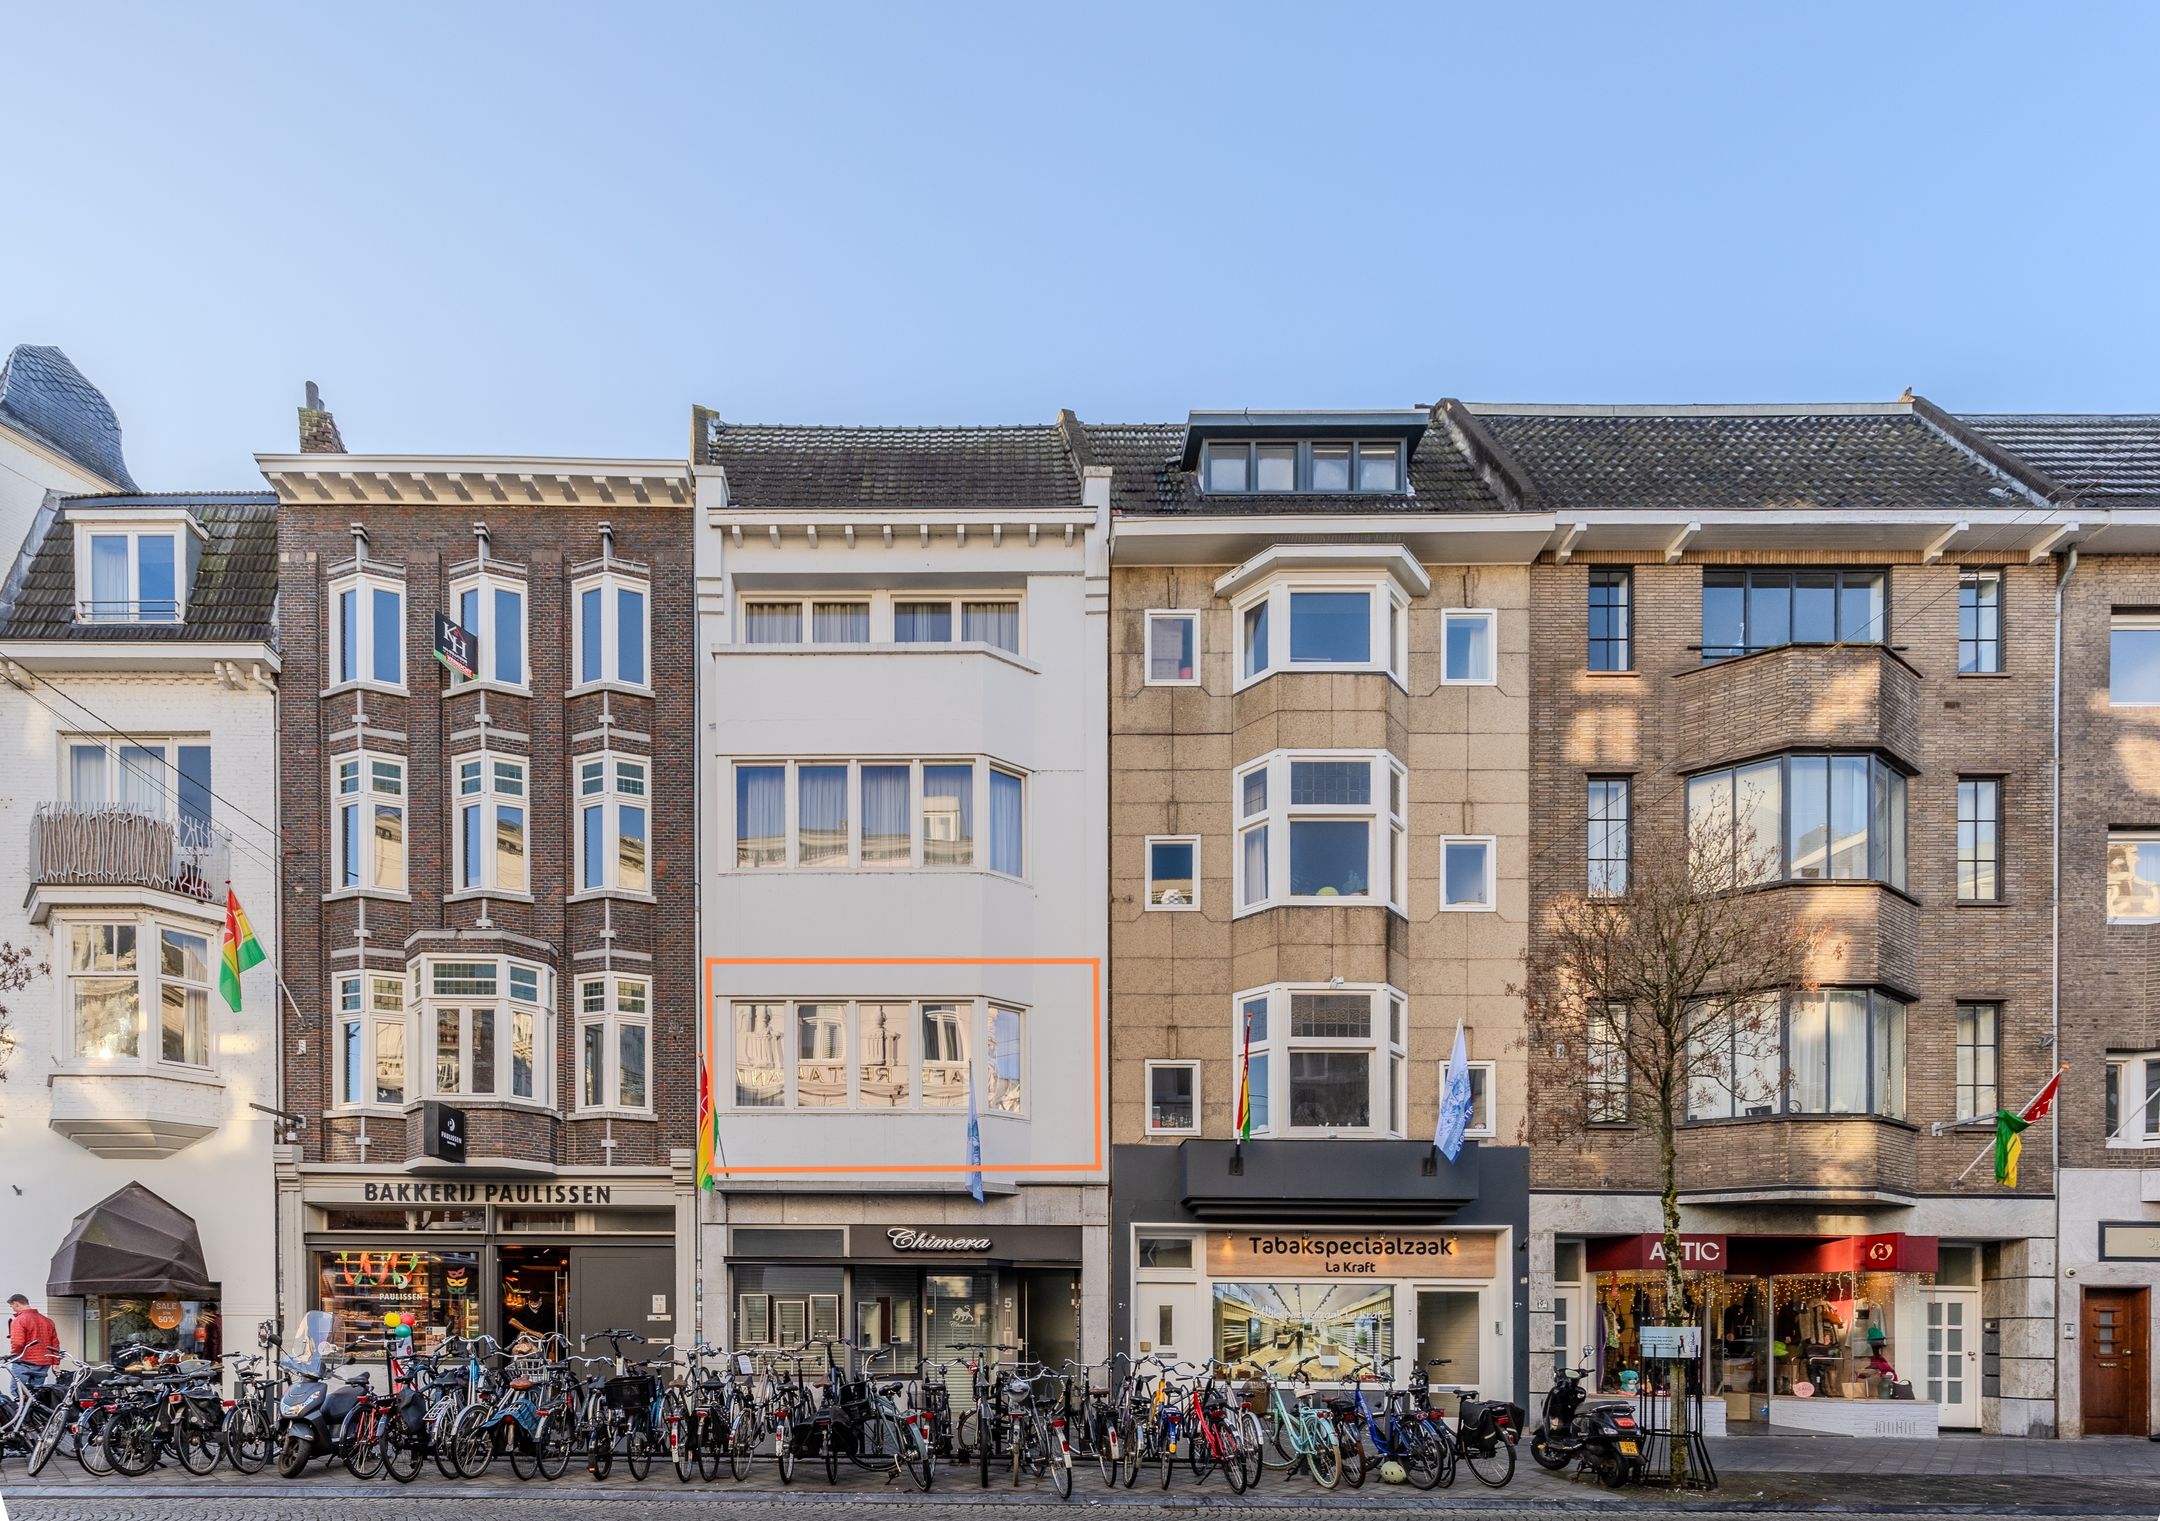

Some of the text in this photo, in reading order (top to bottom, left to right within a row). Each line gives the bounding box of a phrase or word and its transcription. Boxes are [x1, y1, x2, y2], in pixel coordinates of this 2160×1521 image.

[364, 1182, 611, 1204] BAKKERIJ PAULISSEN
[887, 1227, 992, 1250] Chimera
[1249, 1236, 1453, 1258] Tabakspeciaalzaak
[1649, 1241, 1720, 1261] ATIC
[1325, 1261, 1376, 1273] La Kraft
[156, 1302, 177, 1310] SALE
[1004, 1298, 1012, 1309] 5
[158, 1315, 175, 1323] 50%
